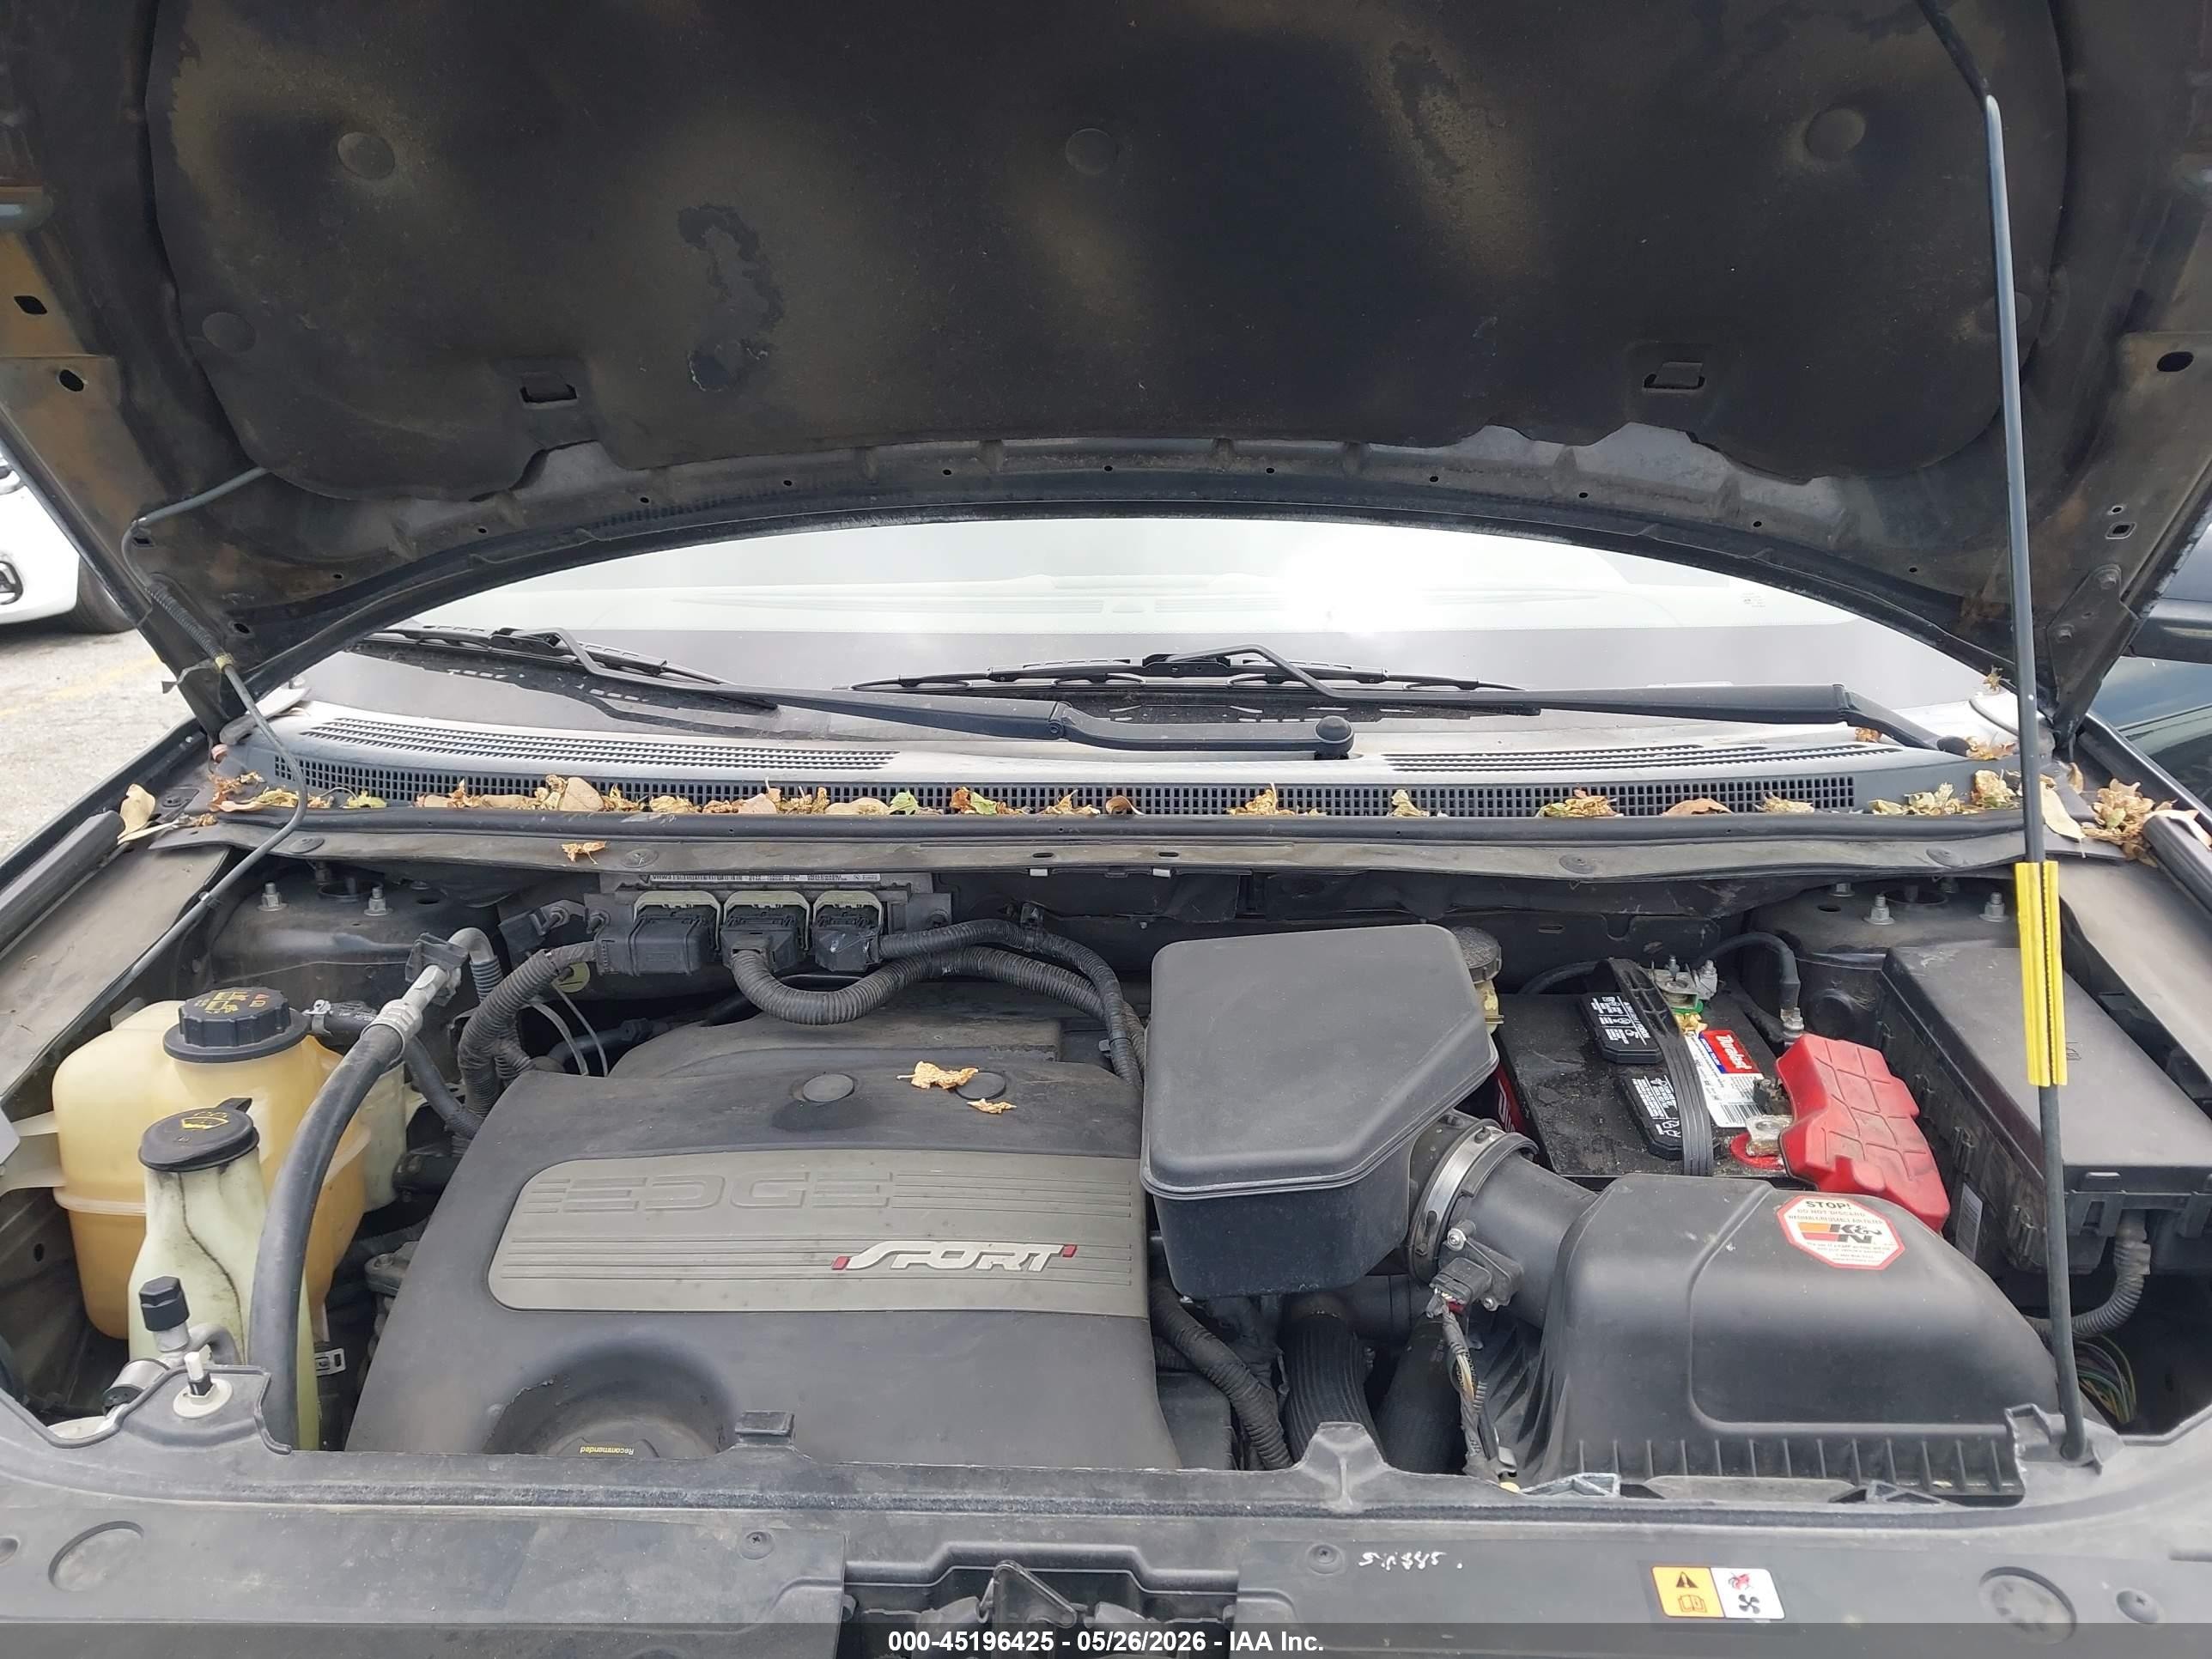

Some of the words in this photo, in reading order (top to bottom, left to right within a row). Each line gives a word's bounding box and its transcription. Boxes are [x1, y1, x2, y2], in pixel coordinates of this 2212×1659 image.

[1715, 1034, 1753, 1070] Duralast
[562, 1171, 893, 1213] EDGE
[1806, 1200, 1851, 1210] STOP!
[845, 1241, 1065, 1272] SPORT
[580, 1446, 635, 1455] Recommended
